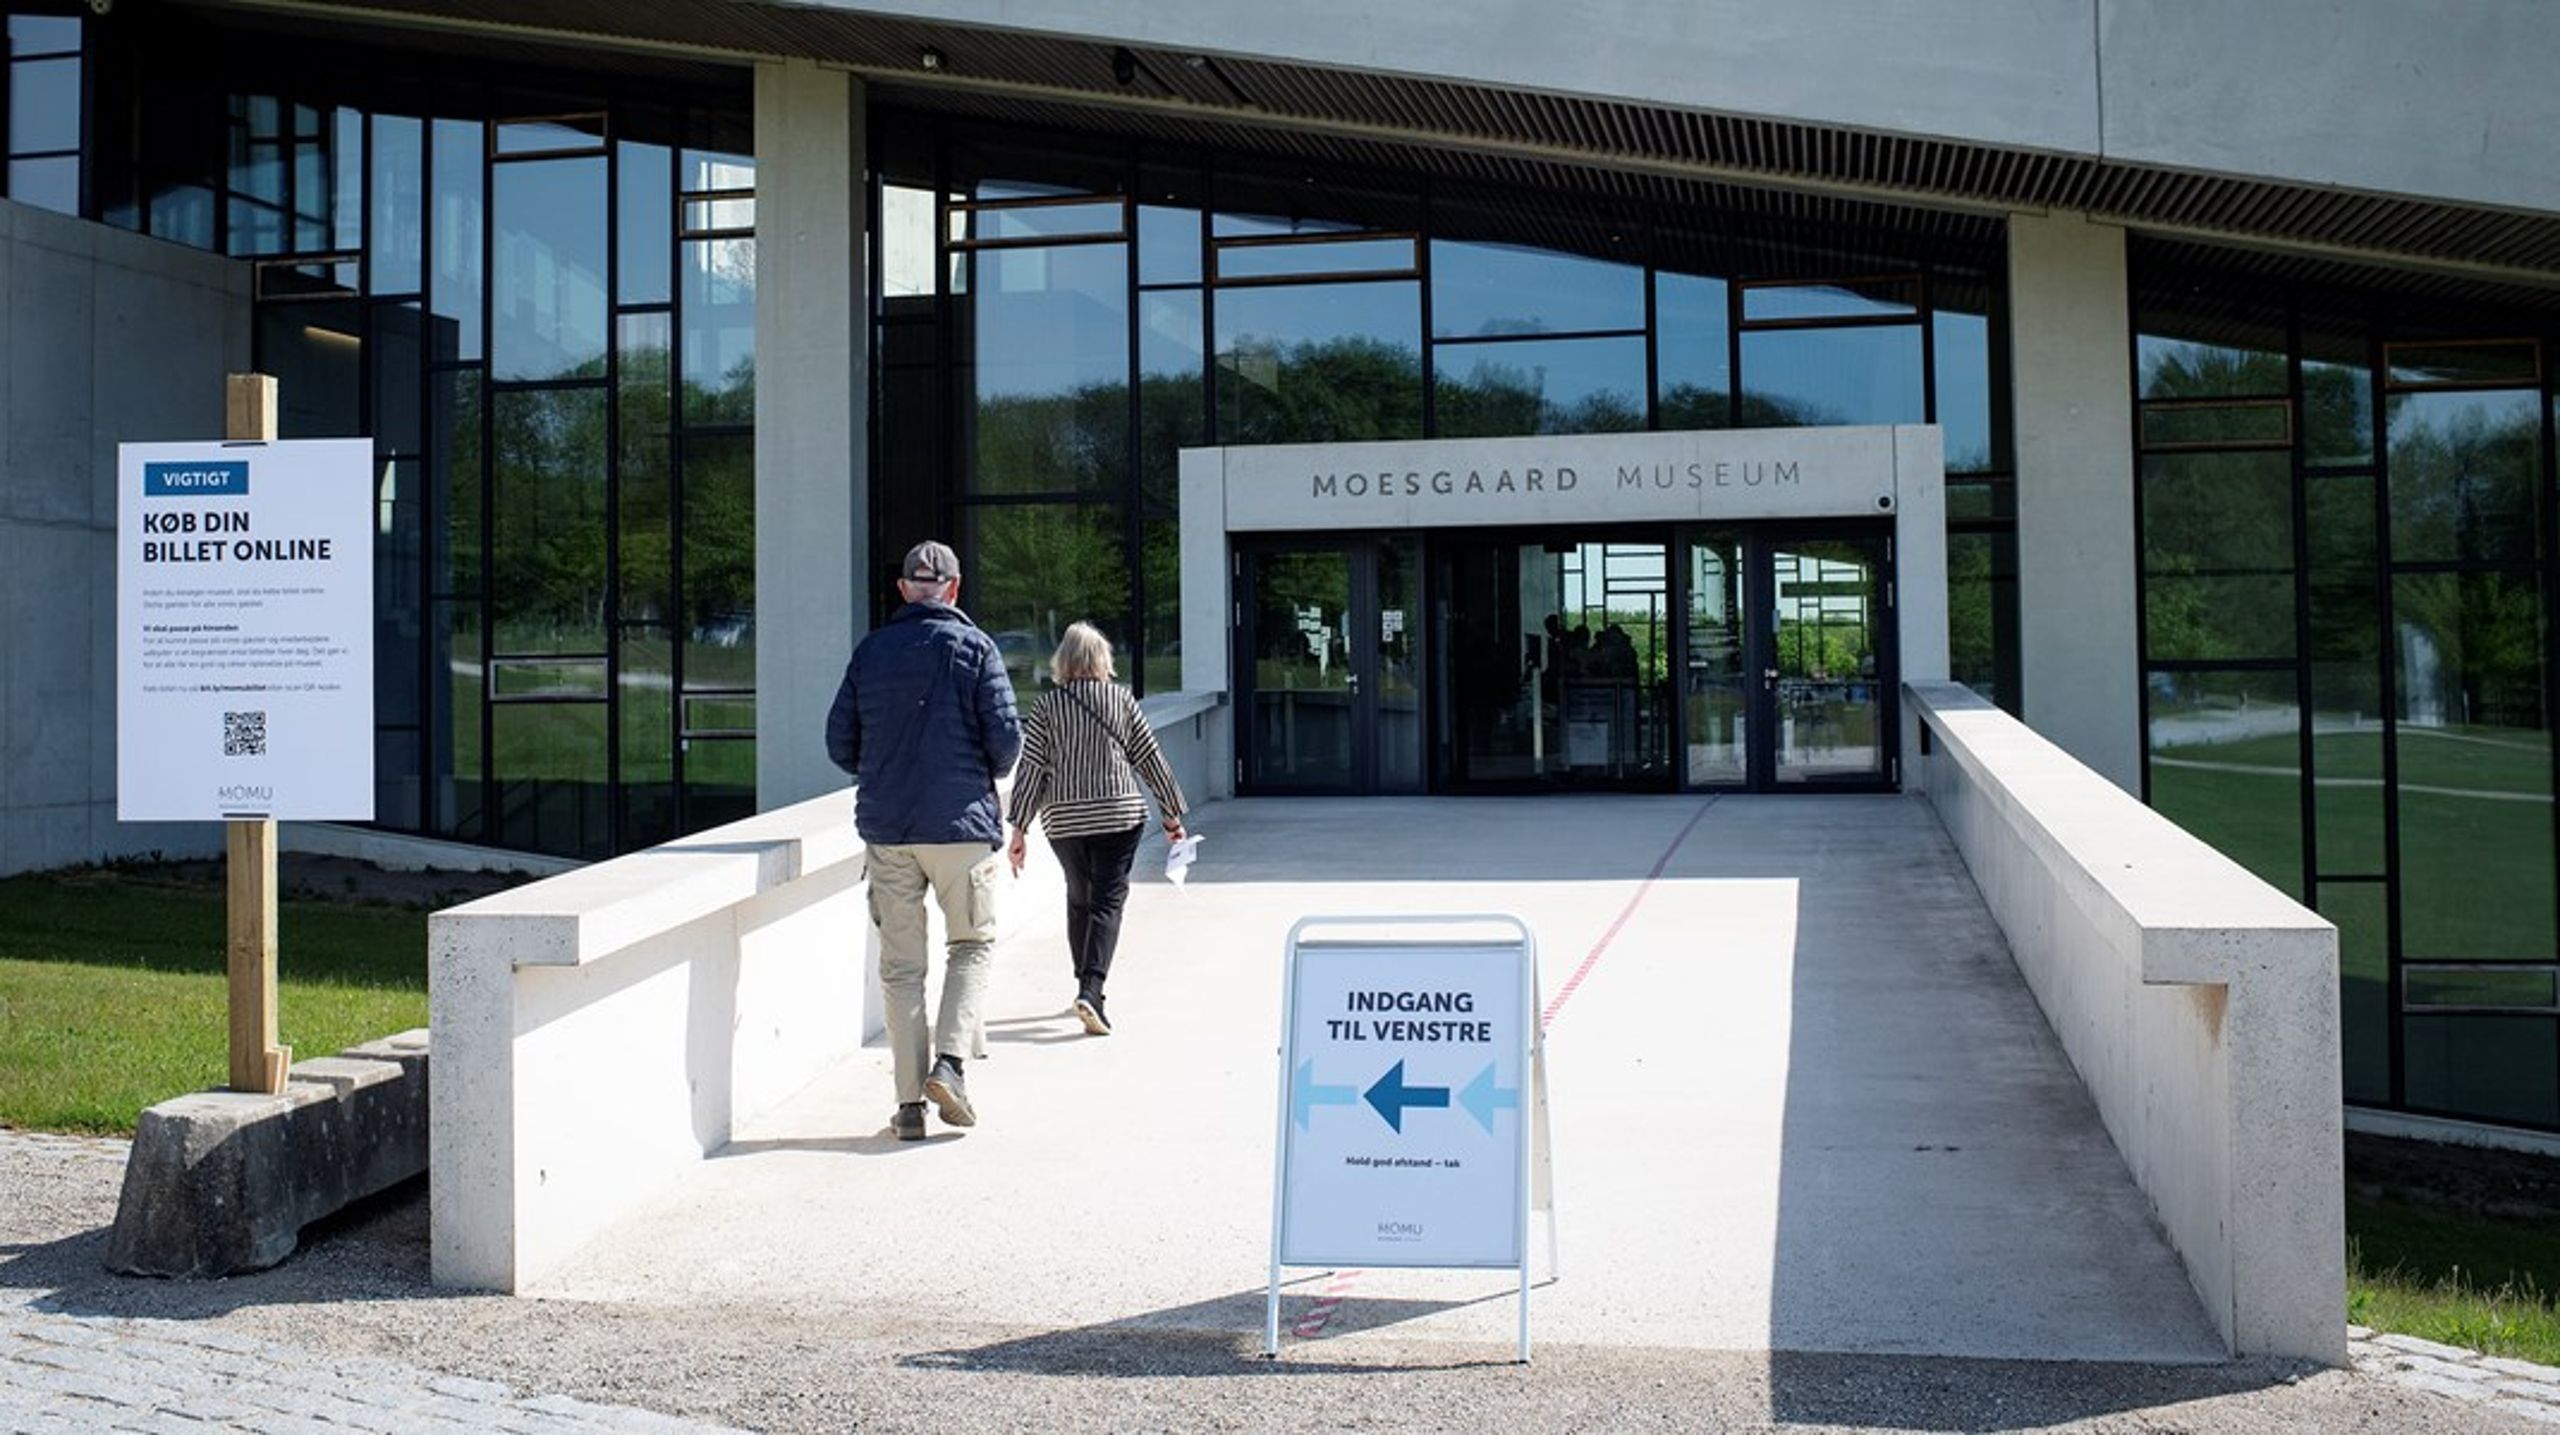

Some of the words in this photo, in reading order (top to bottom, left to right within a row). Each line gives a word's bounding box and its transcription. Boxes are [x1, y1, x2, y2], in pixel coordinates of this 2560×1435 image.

[163, 471, 231, 487] VIGTIGT
[1312, 467, 1578, 498] MOESGAARD
[1617, 461, 1800, 490] MUSEUM
[143, 512, 197, 534] KØB
[205, 511, 250, 532] DIN
[143, 540, 228, 563] BILLET
[233, 539, 332, 561] ONLINE
[1347, 991, 1473, 1013] INDGANG
[1327, 1020, 1367, 1041] TIL
[1373, 1021, 1492, 1042] VENSTRE
[1346, 1156, 1371, 1166] Hold
[1373, 1157, 1393, 1168] god
[1395, 1157, 1433, 1168] afstand
[1444, 1158, 1460, 1168] tak
